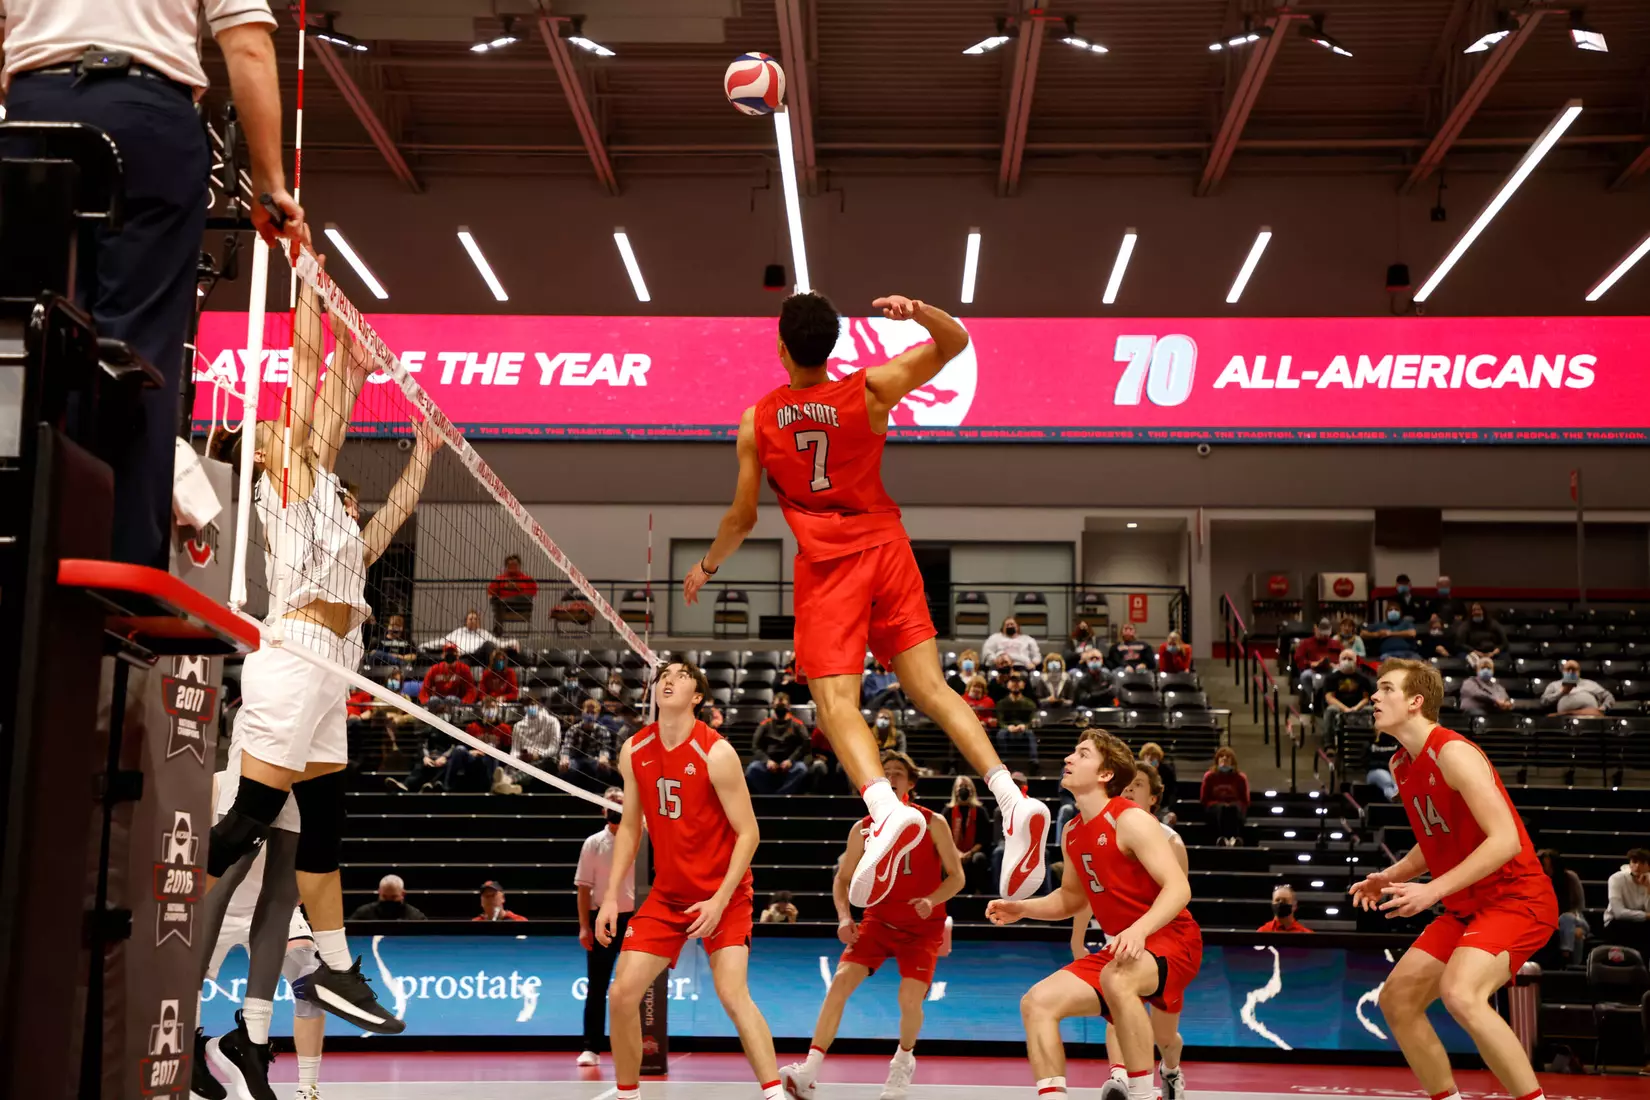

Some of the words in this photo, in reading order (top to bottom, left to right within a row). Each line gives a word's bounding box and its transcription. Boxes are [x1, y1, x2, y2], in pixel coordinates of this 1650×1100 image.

[437, 352, 525, 386] THE
[534, 352, 652, 387] YEAR
[1113, 333, 1198, 406] 70
[1213, 353, 1597, 389] ALL-AMERICANS
[803, 402, 840, 428] STATE
[795, 430, 832, 492] 7
[175, 685, 205, 712] 2011
[656, 776, 682, 820] 15
[1413, 794, 1451, 836] 14
[163, 868, 194, 894] 2016
[1081, 853, 1105, 894] 5
[394, 970, 542, 1009] prostate
[150, 1059, 180, 1088] 2017
